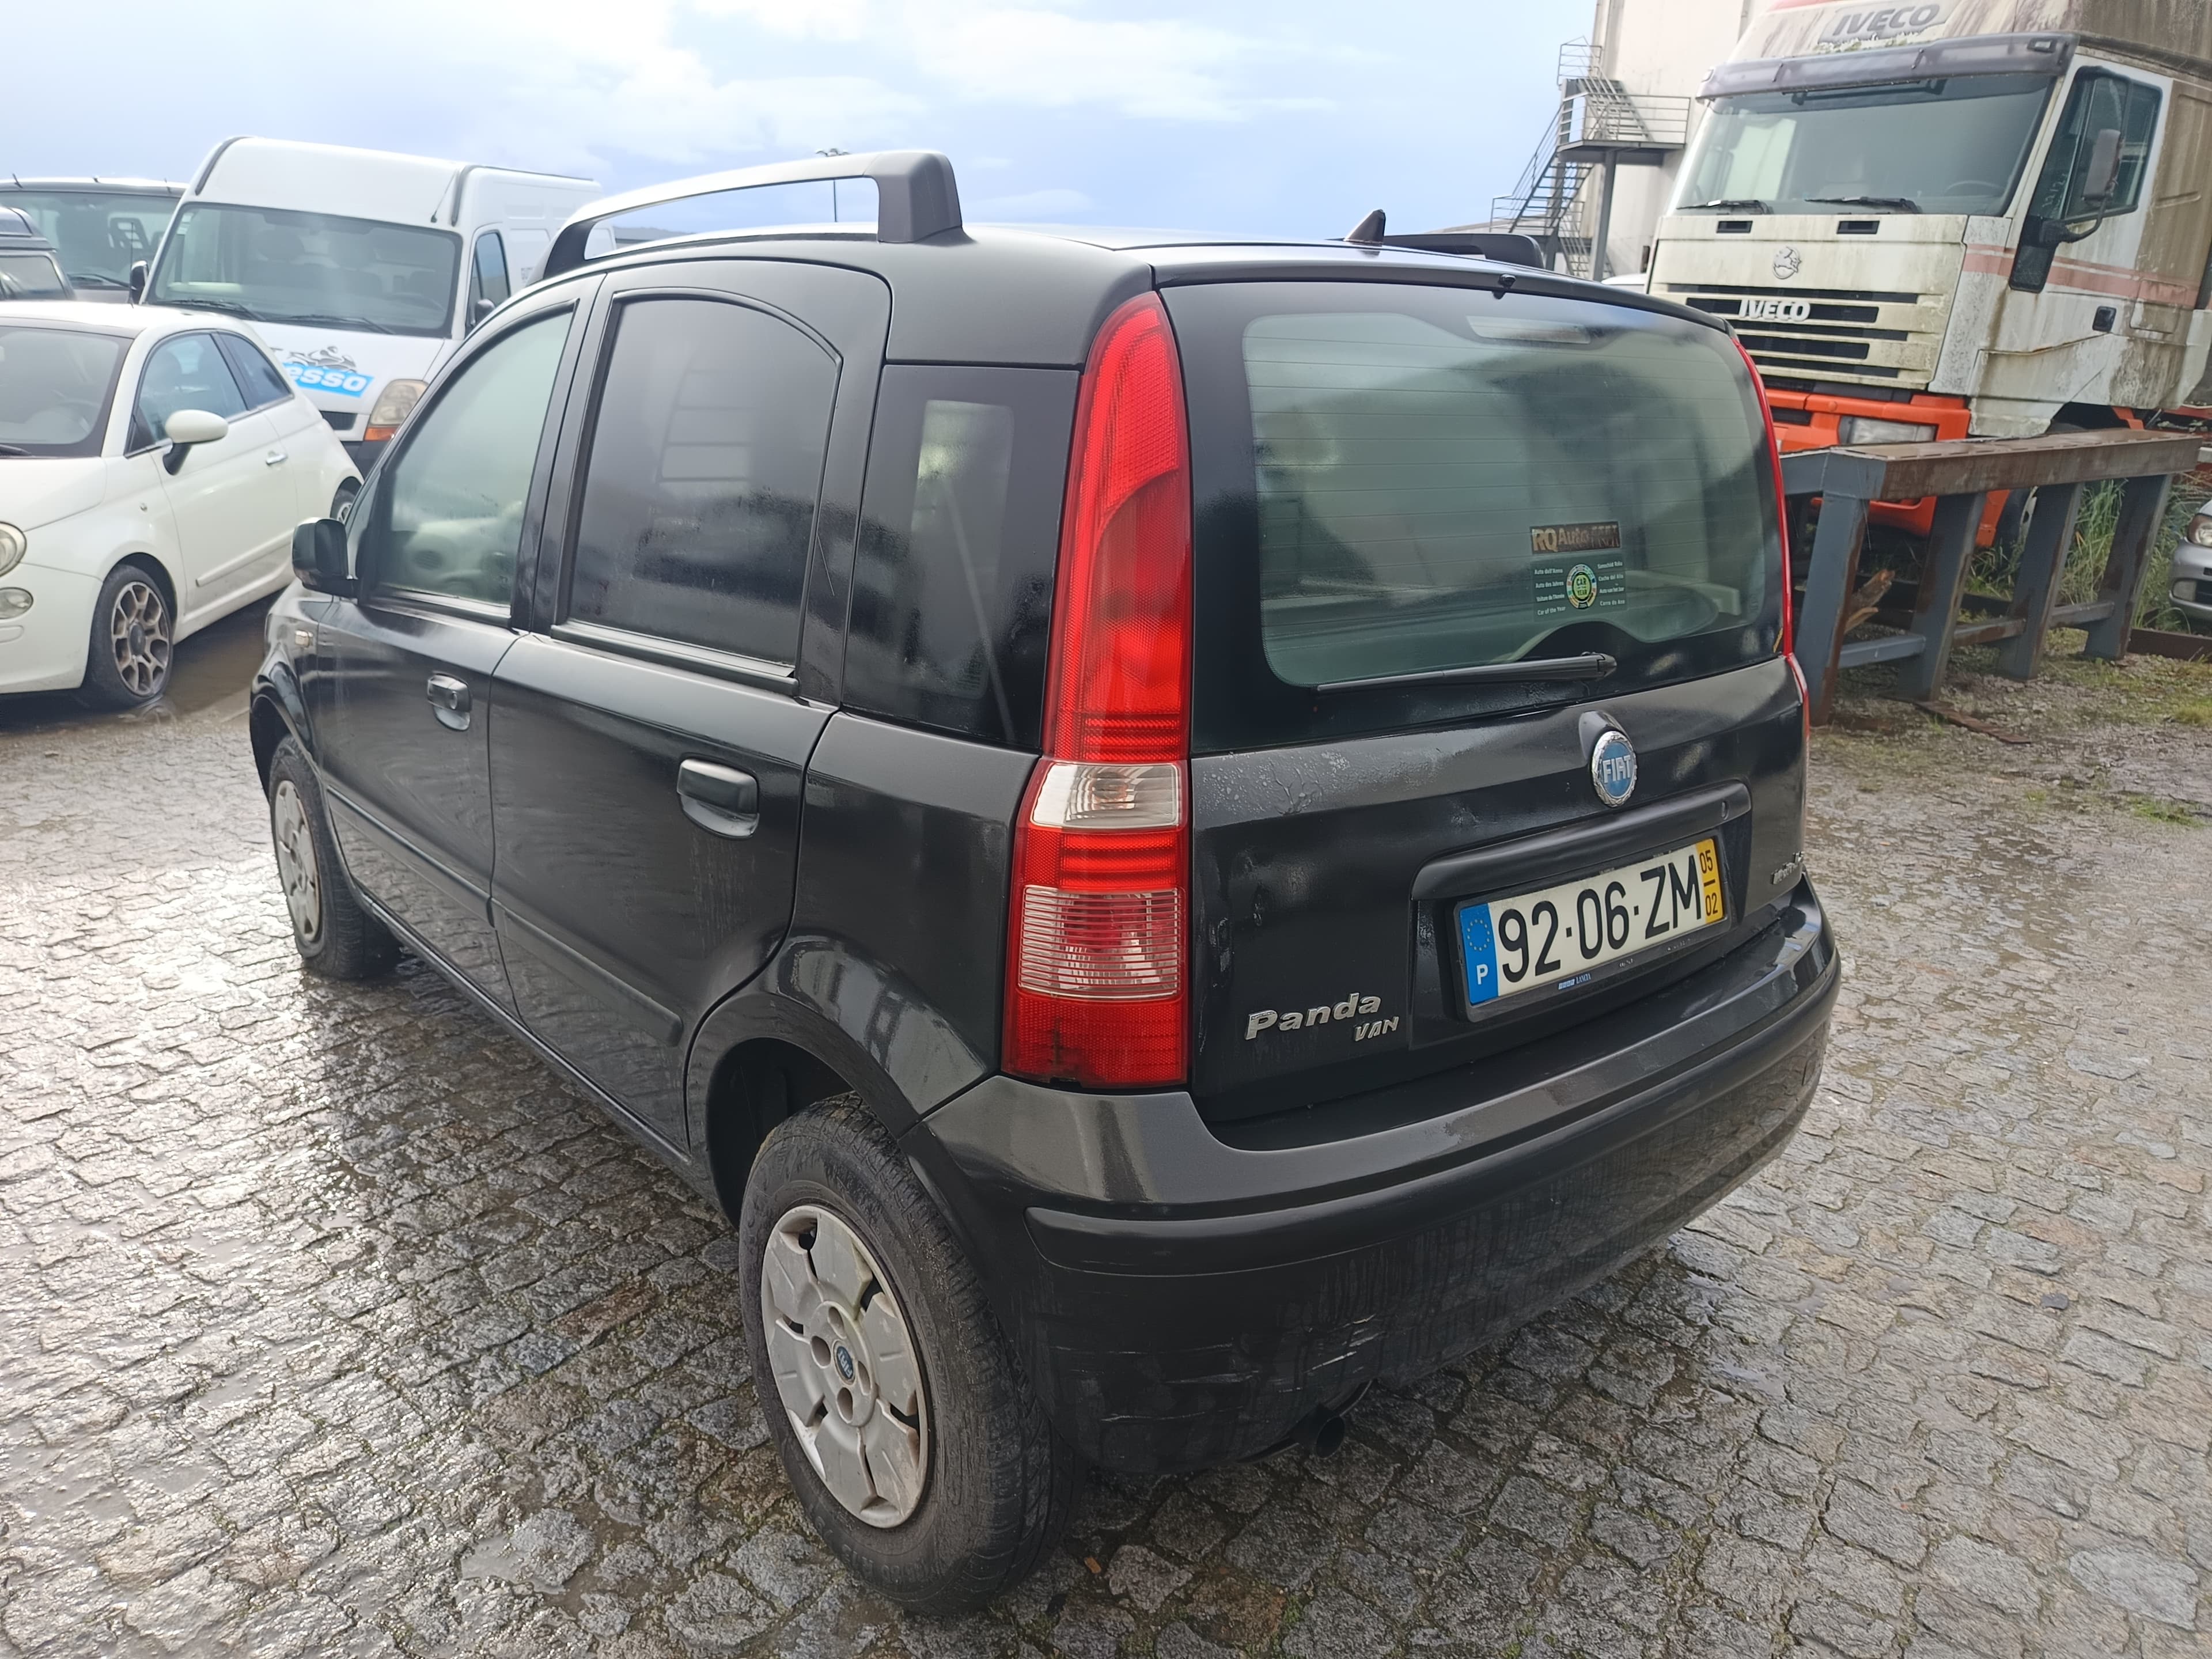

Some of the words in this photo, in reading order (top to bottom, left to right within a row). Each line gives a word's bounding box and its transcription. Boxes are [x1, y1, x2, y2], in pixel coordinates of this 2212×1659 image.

[1832, 3, 1940, 36] IVECO
[1738, 299, 1811, 322] IVECO
[1576, 578, 1586, 586] CAR
[1603, 755, 1631, 783] FIAT
[1699, 850, 1713, 874] 05
[1705, 892, 1718, 916] 02
[1476, 964, 1488, 985] P
[1244, 992, 1381, 1040] Panda
[1355, 1016, 1399, 1041] VAN
